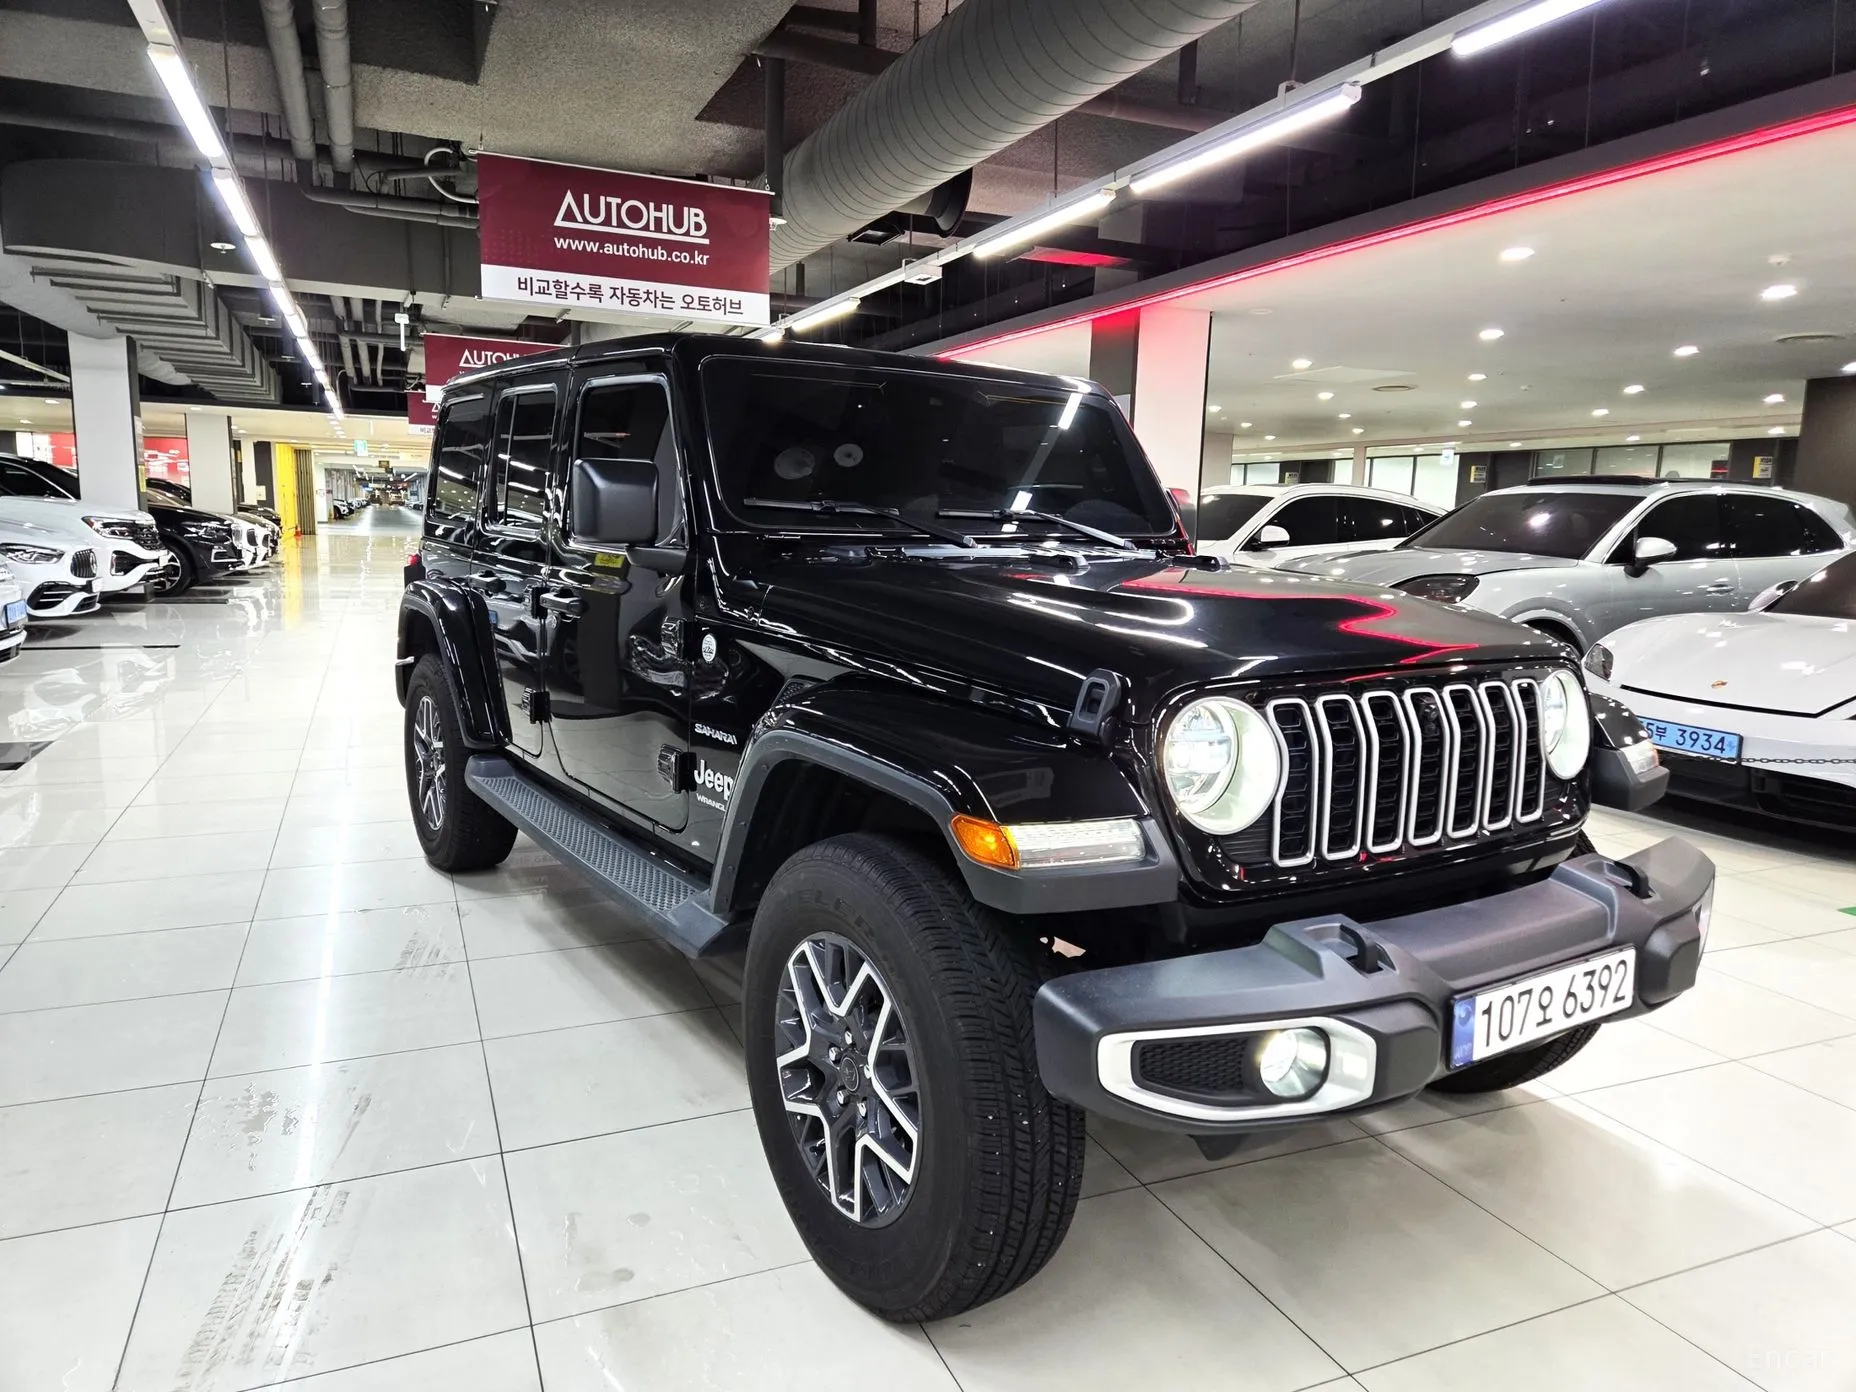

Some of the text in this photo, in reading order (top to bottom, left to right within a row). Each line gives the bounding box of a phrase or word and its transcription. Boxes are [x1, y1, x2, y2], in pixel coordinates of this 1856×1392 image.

[554, 190, 709, 245] AUTOHUB
[554, 237, 710, 266] www.autohub.co.kr
[517, 276, 744, 315] 비교할수록 자동차는 오토허브
[1640, 721, 1726, 754] 5부 3934
[694, 759, 734, 801] Jeep
[1481, 959, 1628, 1047] 107오 6392
